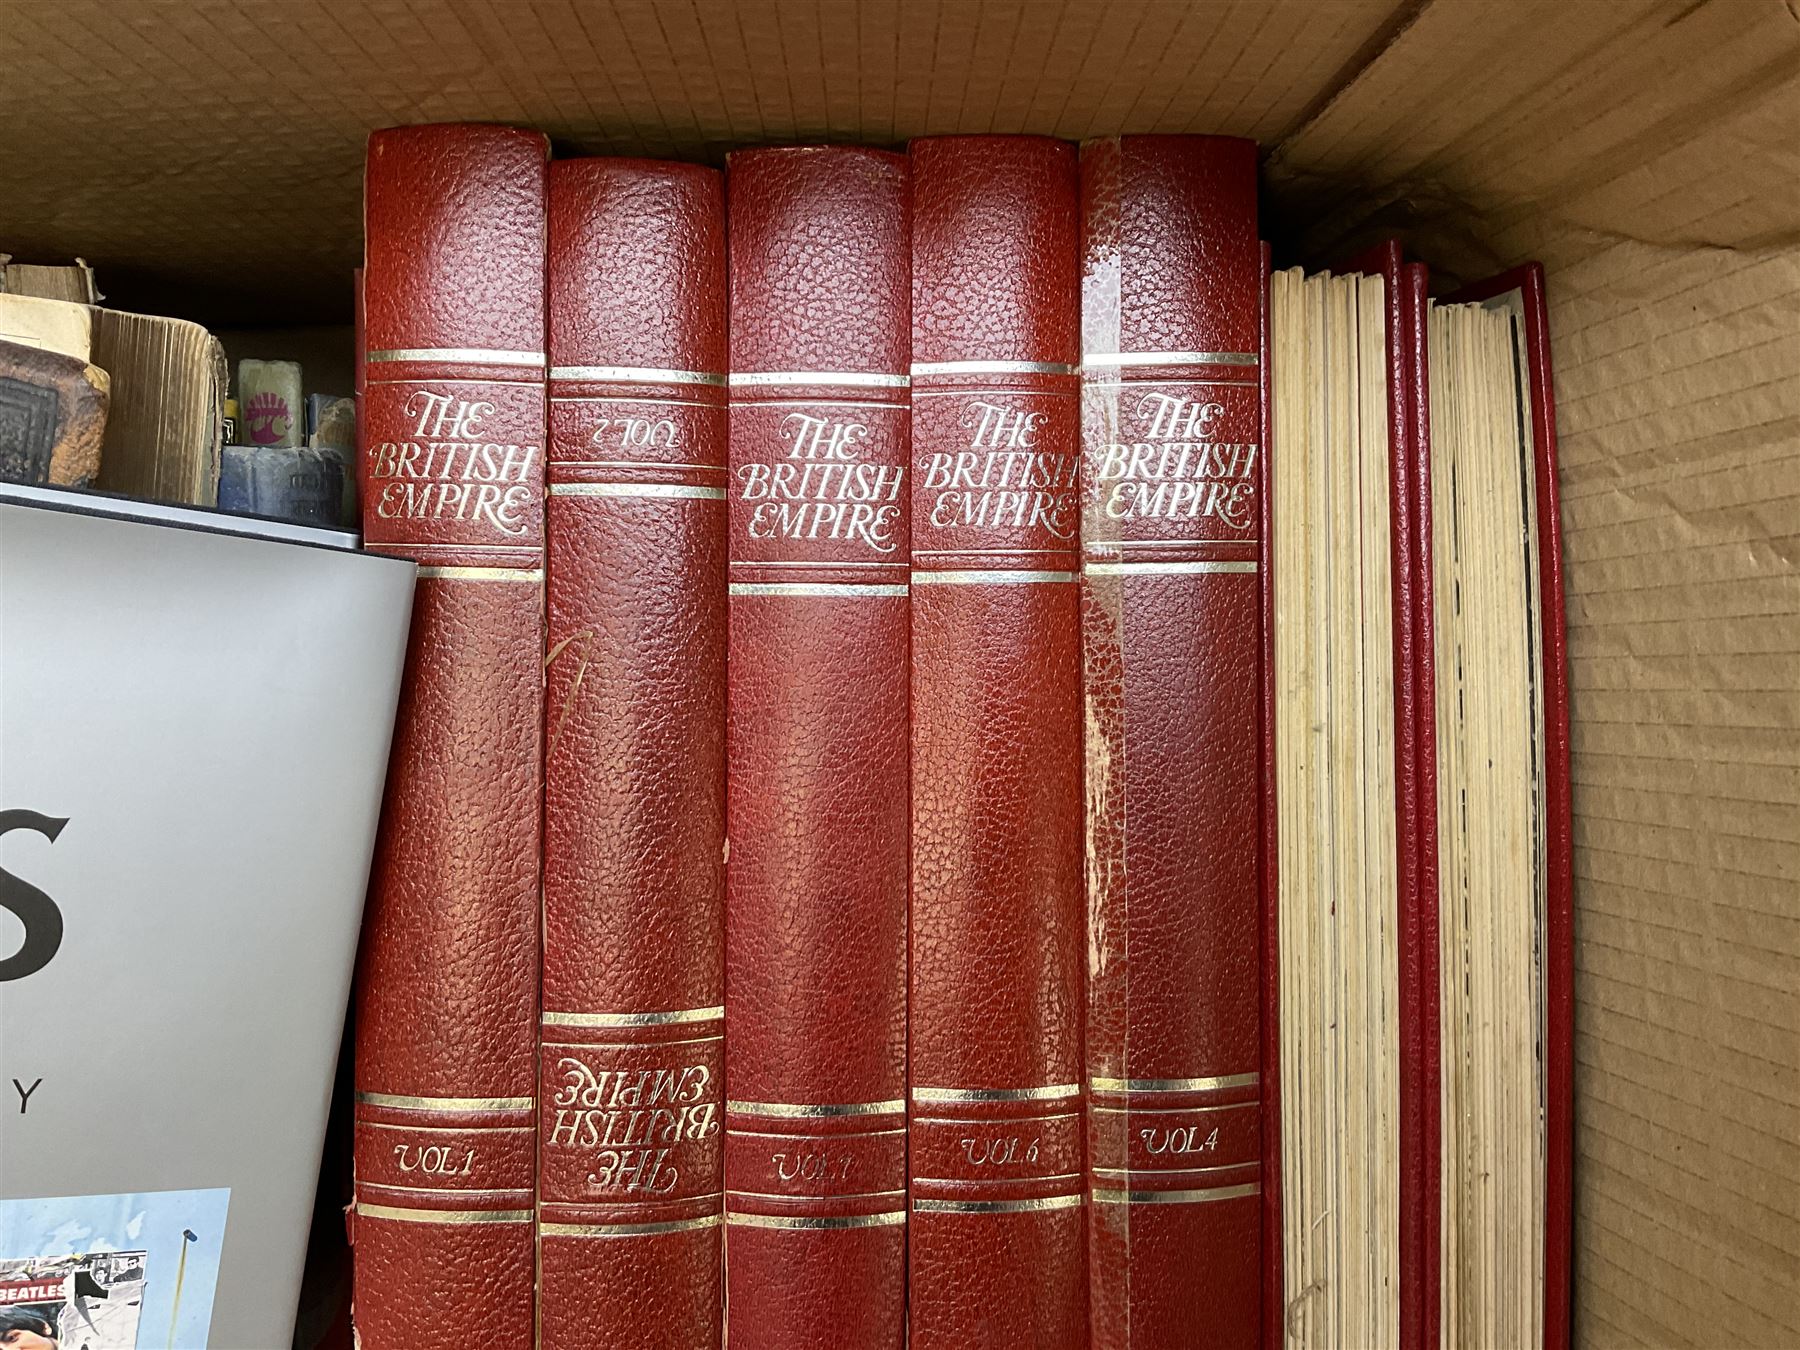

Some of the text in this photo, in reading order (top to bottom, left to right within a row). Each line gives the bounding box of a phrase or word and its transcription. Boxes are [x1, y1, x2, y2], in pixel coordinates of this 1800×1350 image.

[405, 390, 496, 439] THE
[779, 412, 867, 460] THE
[962, 401, 1048, 448] THE
[1137, 392, 1224, 439] THE
[369, 441, 538, 482] BRITISH
[737, 462, 908, 501] BRITISH
[919, 451, 1080, 489] BRITISH
[1094, 442, 1259, 480] BRITISH
[377, 481, 531, 535] EMPIRE
[749, 502, 901, 553] EMPIRE
[930, 490, 1076, 539] EMPIRE
[1105, 481, 1254, 530] EMPIRE
[555, 1057, 711, 1109] EMPIRE
[548, 1102, 721, 1147] BRITISH
[587, 1148, 679, 1193] THE
